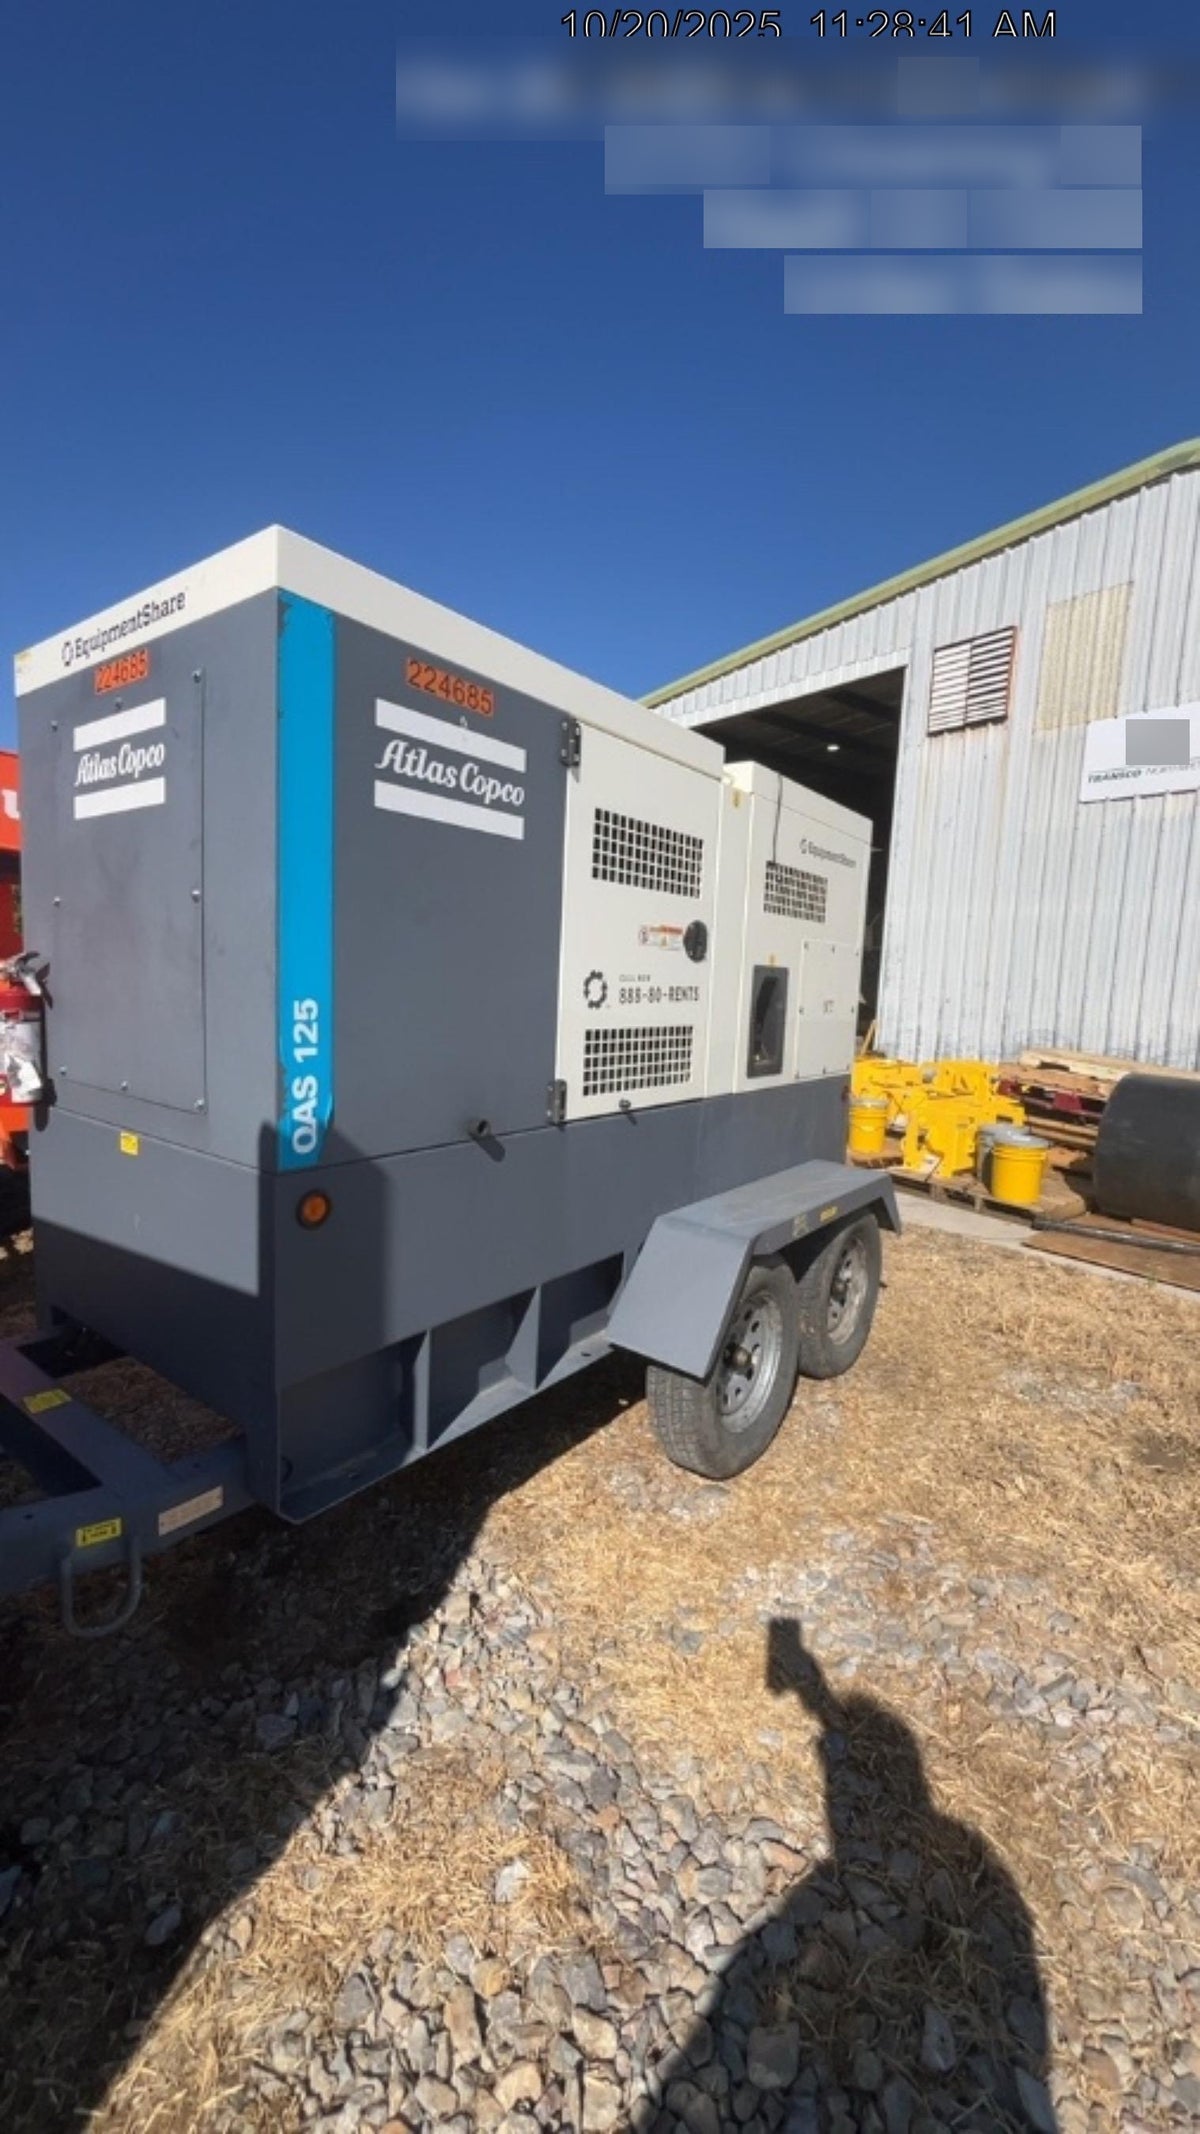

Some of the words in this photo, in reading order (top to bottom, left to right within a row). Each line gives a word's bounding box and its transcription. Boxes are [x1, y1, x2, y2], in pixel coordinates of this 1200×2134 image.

[75, 591, 186, 659] EquipmentShare
[96, 648, 147, 693] 224685
[408, 660, 493, 715] 224685
[74, 752, 117, 787] Atlas
[118, 742, 165, 779] Copco
[374, 739, 458, 788] Atlas
[459, 762, 525, 806] Copco
[293, 998, 319, 1064] 125
